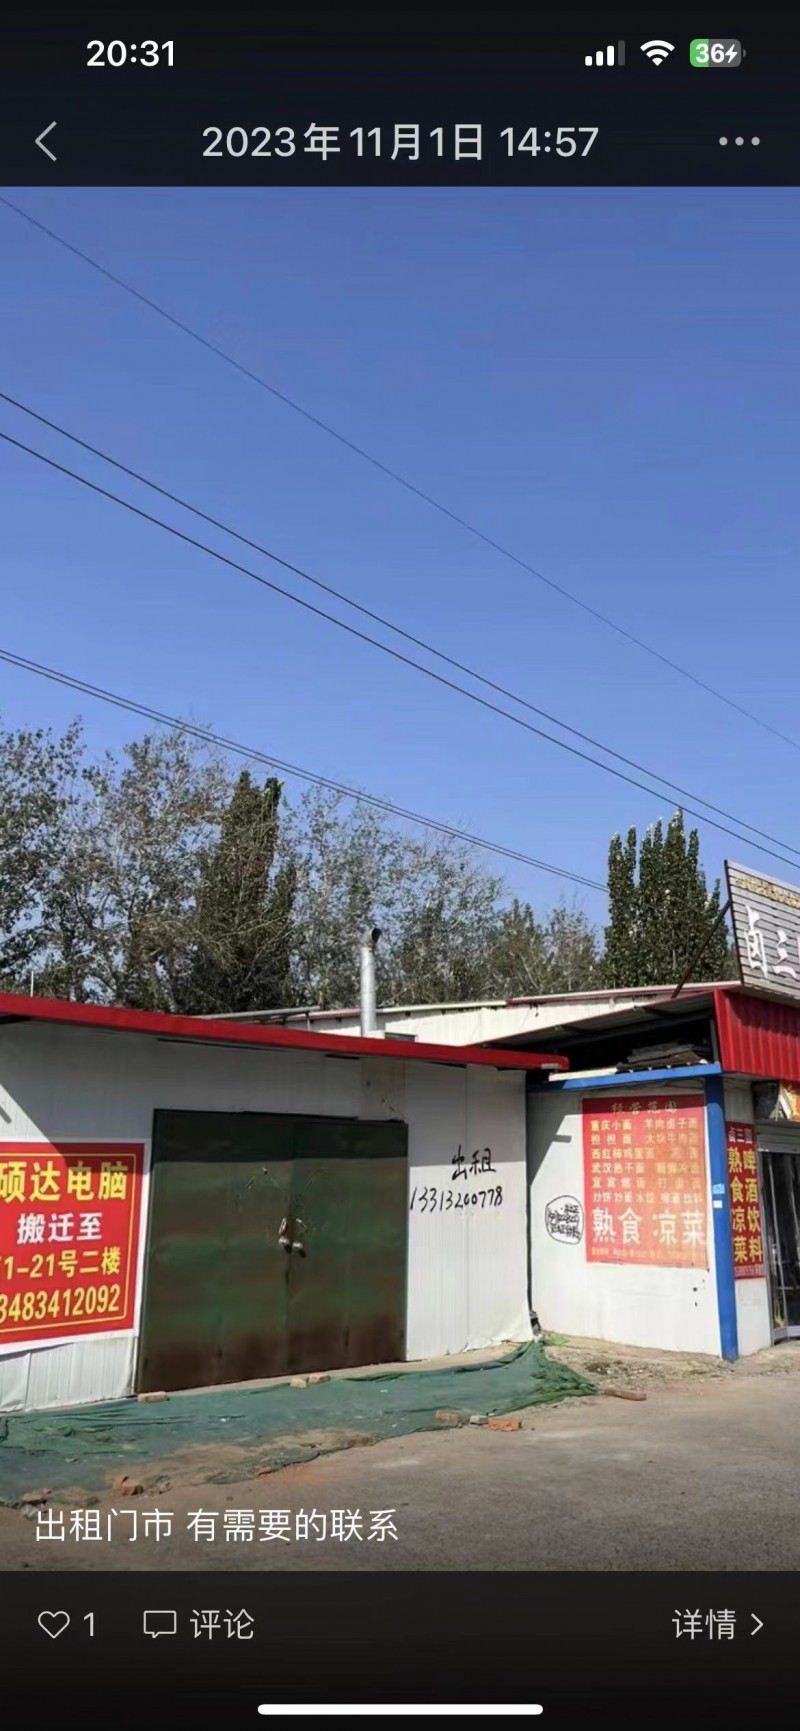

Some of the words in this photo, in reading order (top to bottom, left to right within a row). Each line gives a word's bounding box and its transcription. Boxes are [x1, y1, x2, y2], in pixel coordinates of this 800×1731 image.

[744, 905, 800, 979] 卤三
[591, 1119, 632, 1131] 重庆小面
[0, 1161, 128, 1203] 硕达电脑
[451, 1144, 497, 1181] 出租
[409, 1185, 503, 1213] 13313200778
[728, 1147, 749, 1264] 熟食凉菜
[743, 1148, 763, 1263] 啤酒饮料
[17, 1212, 103, 1244] 搬迁至
[592, 1207, 643, 1244] 熟食
[652, 1208, 705, 1246] 凉菜
[0, 1246, 121, 1280] 1-21号二楼
[0, 1283, 121, 1325] 3483412092
